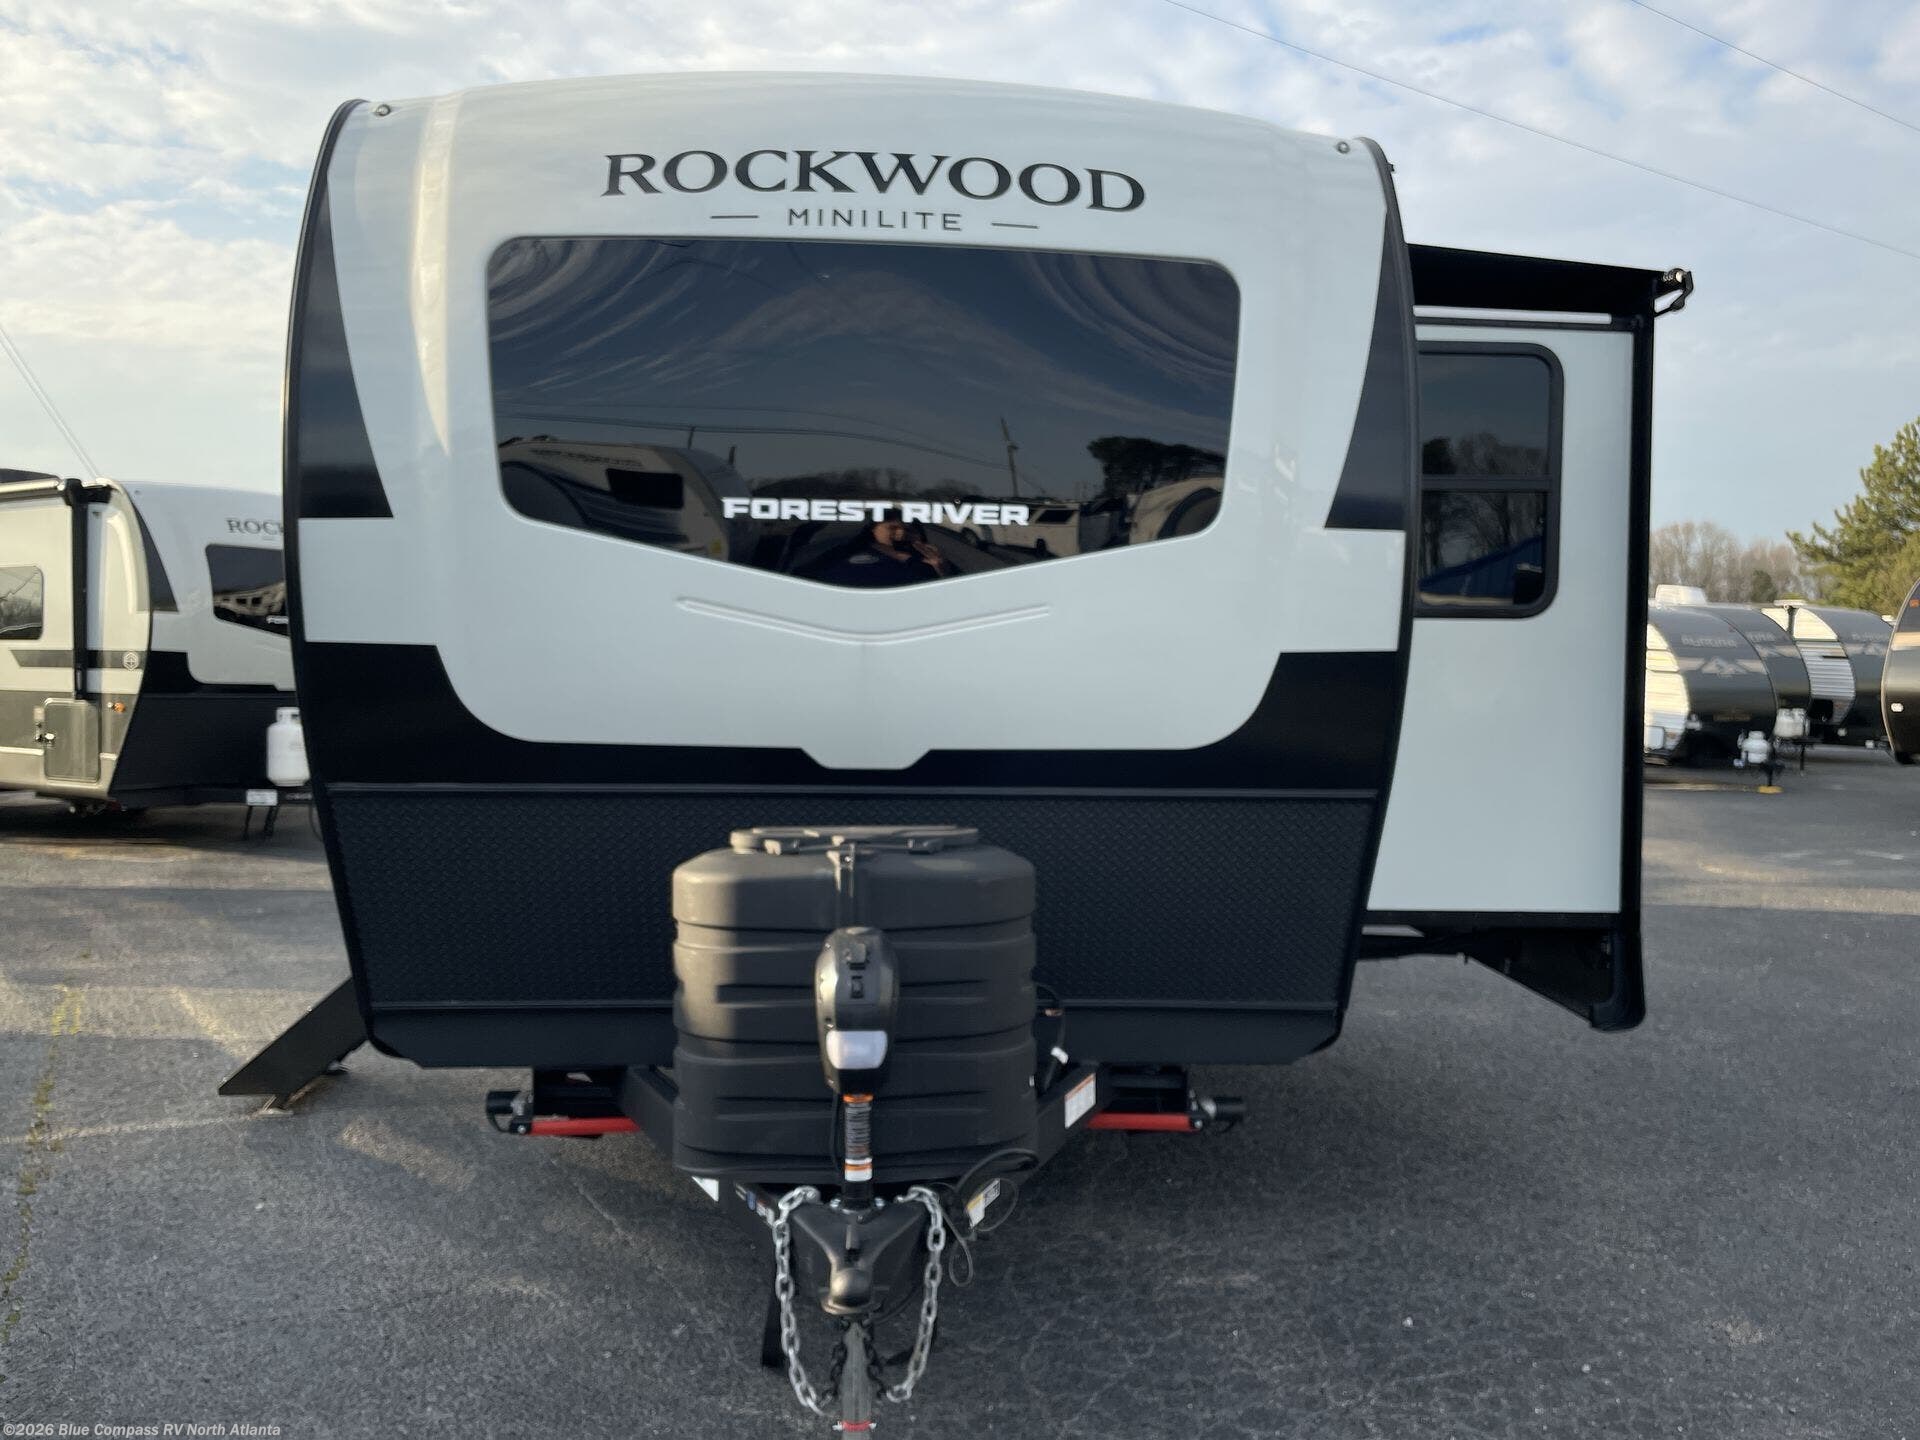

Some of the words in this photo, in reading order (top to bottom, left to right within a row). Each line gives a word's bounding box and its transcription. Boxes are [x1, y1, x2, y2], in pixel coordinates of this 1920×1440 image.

[601, 149, 1146, 212] ROCKWOOD
[787, 208, 963, 231] MINILITE
[721, 496, 893, 522] FOREST
[901, 501, 1029, 526] RIVER
